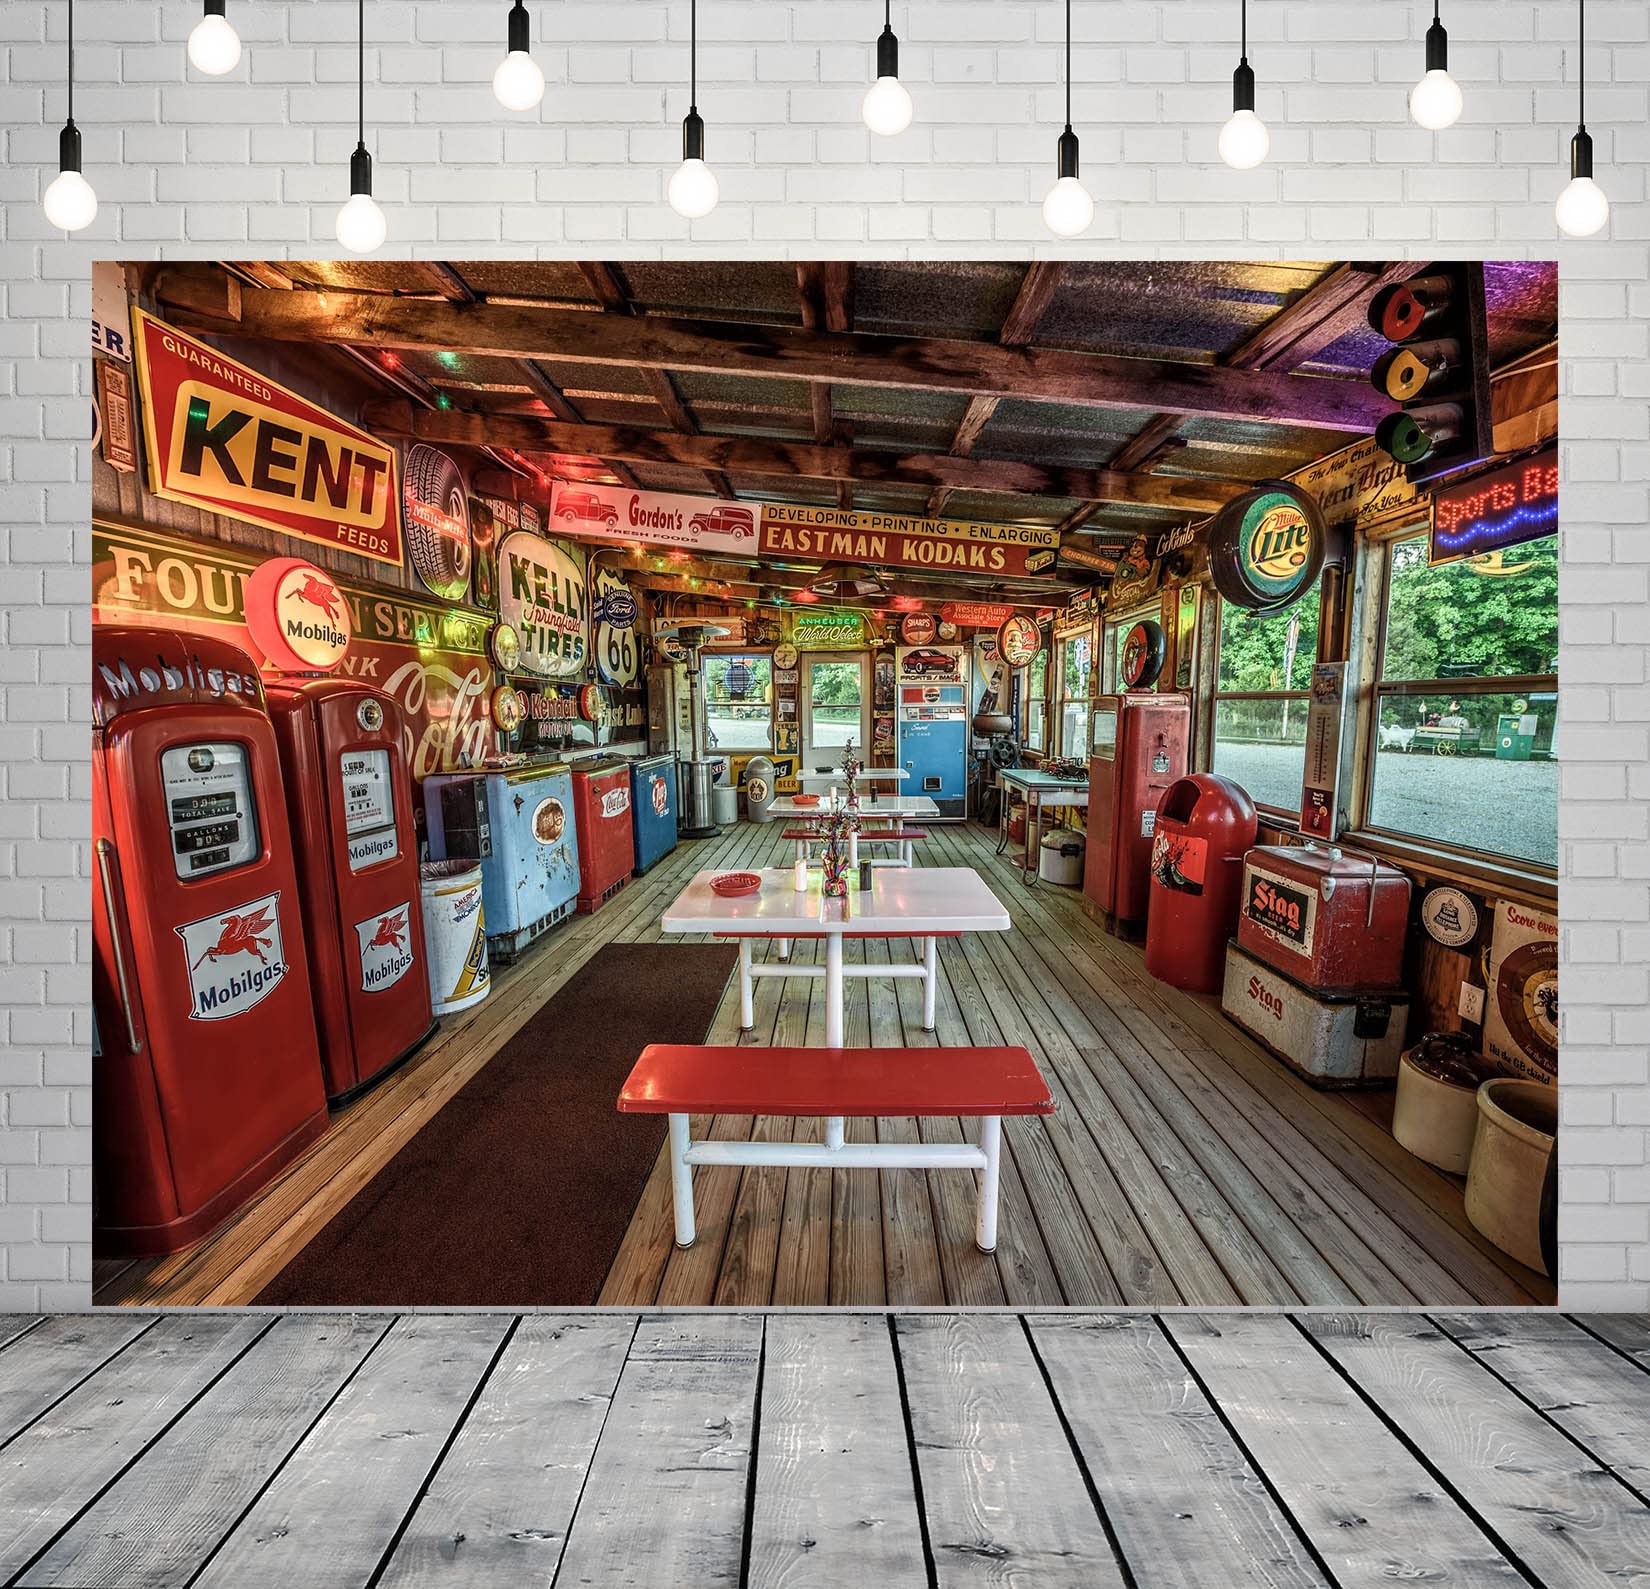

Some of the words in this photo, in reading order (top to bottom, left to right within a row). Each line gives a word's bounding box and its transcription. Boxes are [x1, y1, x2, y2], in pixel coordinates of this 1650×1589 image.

[162, 335, 273, 402] GUARANTEED
[180, 396, 387, 515] KENT
[629, 494, 683, 531] Gordon's
[768, 507, 858, 526] DEVELOPING
[871, 517, 948, 535] PRINTING
[969, 525, 1053, 545] ENLARGING
[1270, 512, 1302, 530] Miller
[1437, 483, 1515, 533] Sports
[336, 524, 389, 554] FEEDS
[606, 528, 650, 537] FRESH
[653, 534, 699, 543] FOODS
[767, 526, 887, 558] EASTMAN
[902, 538, 1006, 570] KODAKS
[1256, 525, 1308, 562] Lite
[509, 552, 585, 621] KELLY
[375, 603, 480, 650] SERVICE
[523, 593, 581, 638] Springfield
[608, 602, 632, 614] Ford
[907, 618, 931, 628] SHARPS
[952, 612, 982, 621] Associate
[955, 602, 987, 614] Western
[988, 605, 1007, 615] Auto
[287, 620, 347, 648] Mobilgas
[521, 622, 584, 660] TIRES
[608, 628, 632, 674] 66
[792, 624, 832, 641] World
[97, 653, 258, 701] Mobilgas
[531, 693, 577, 720] Kendall
[778, 780, 797, 788] BEER
[186, 825, 229, 838] GALLONS
[350, 839, 394, 861] Mobilgas
[1253, 880, 1300, 930] Stag
[1507, 906, 1536, 929] Score
[199, 962, 283, 1014] Mobilgas
[365, 953, 412, 988] Mobilgas
[1247, 975, 1283, 1020] Stag
